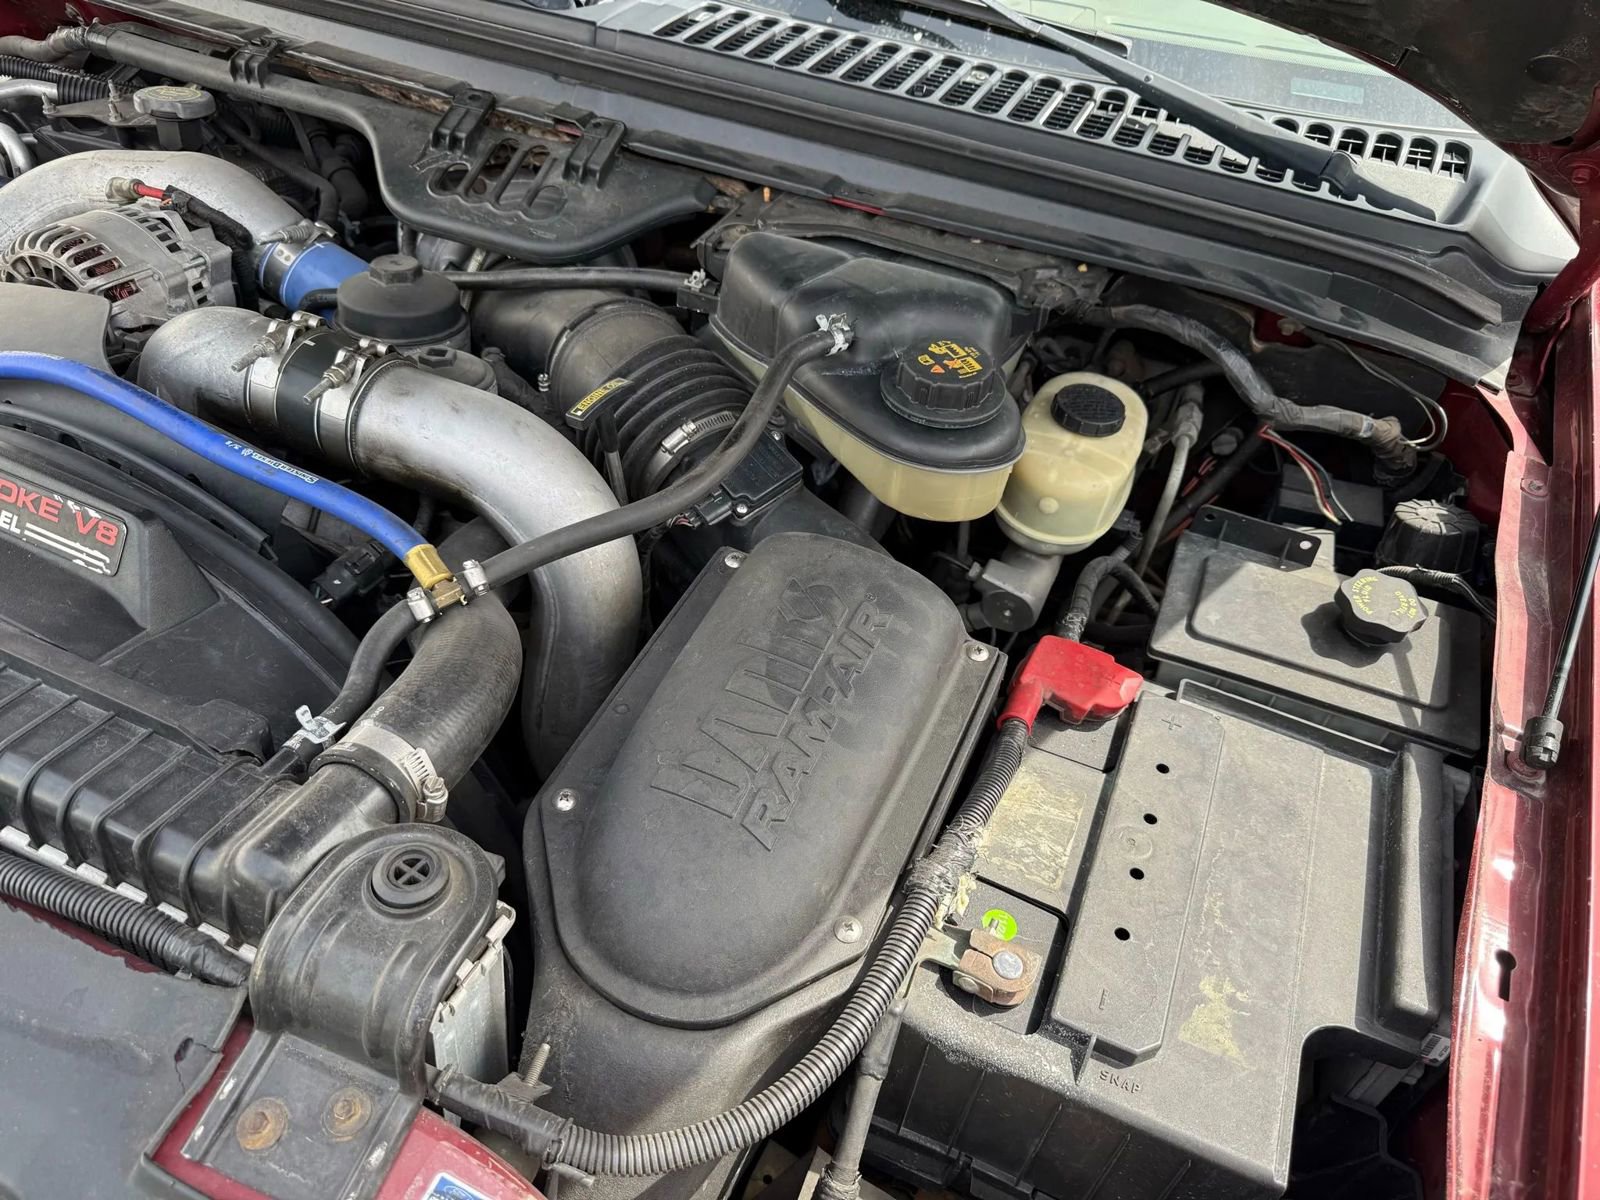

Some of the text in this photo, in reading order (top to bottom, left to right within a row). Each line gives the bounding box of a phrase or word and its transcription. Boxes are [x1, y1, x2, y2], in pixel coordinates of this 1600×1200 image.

[74, 510, 119, 546] V8
[1352, 576, 1378, 592] STEERING
[1099, 1069, 1143, 1095] SNAP
